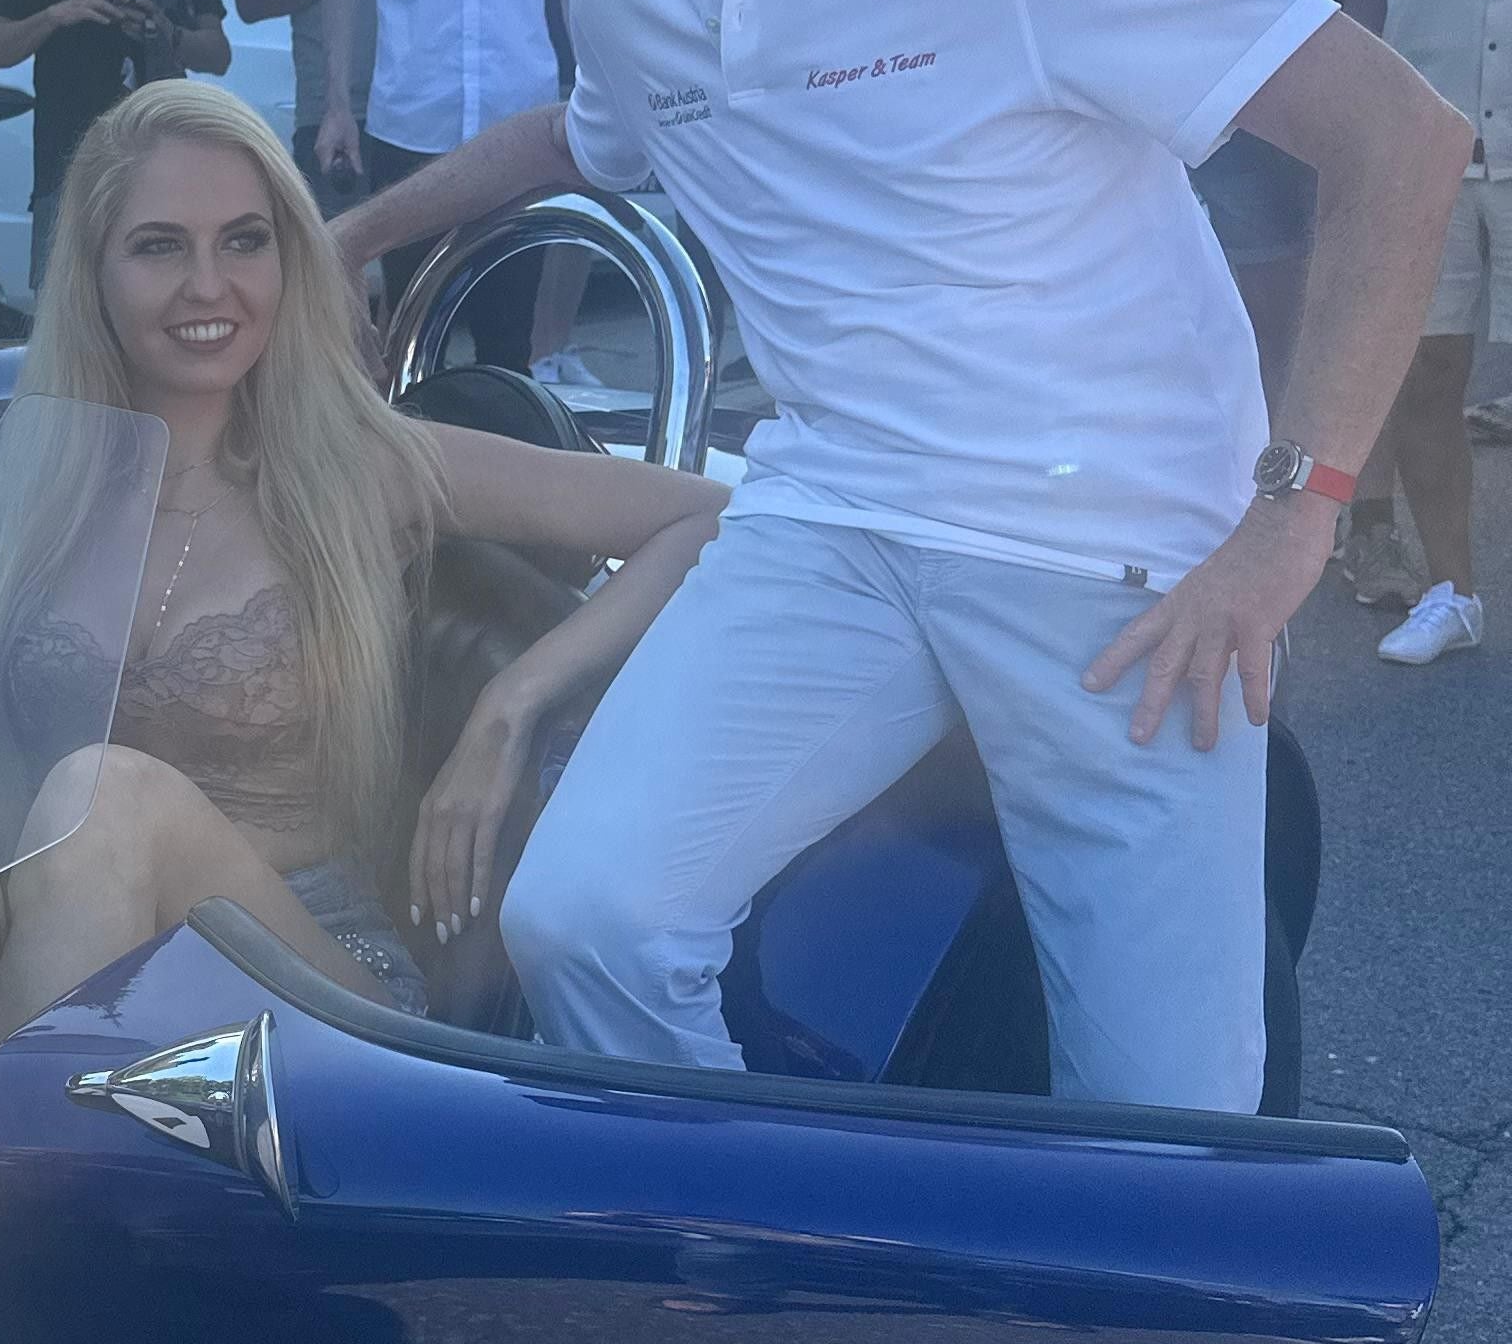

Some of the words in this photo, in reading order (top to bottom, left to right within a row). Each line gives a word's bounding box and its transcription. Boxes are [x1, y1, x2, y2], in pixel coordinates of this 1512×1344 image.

[806, 66, 868, 91] Kasper
[870, 58, 887, 78] &
[889, 53, 937, 73] Team
